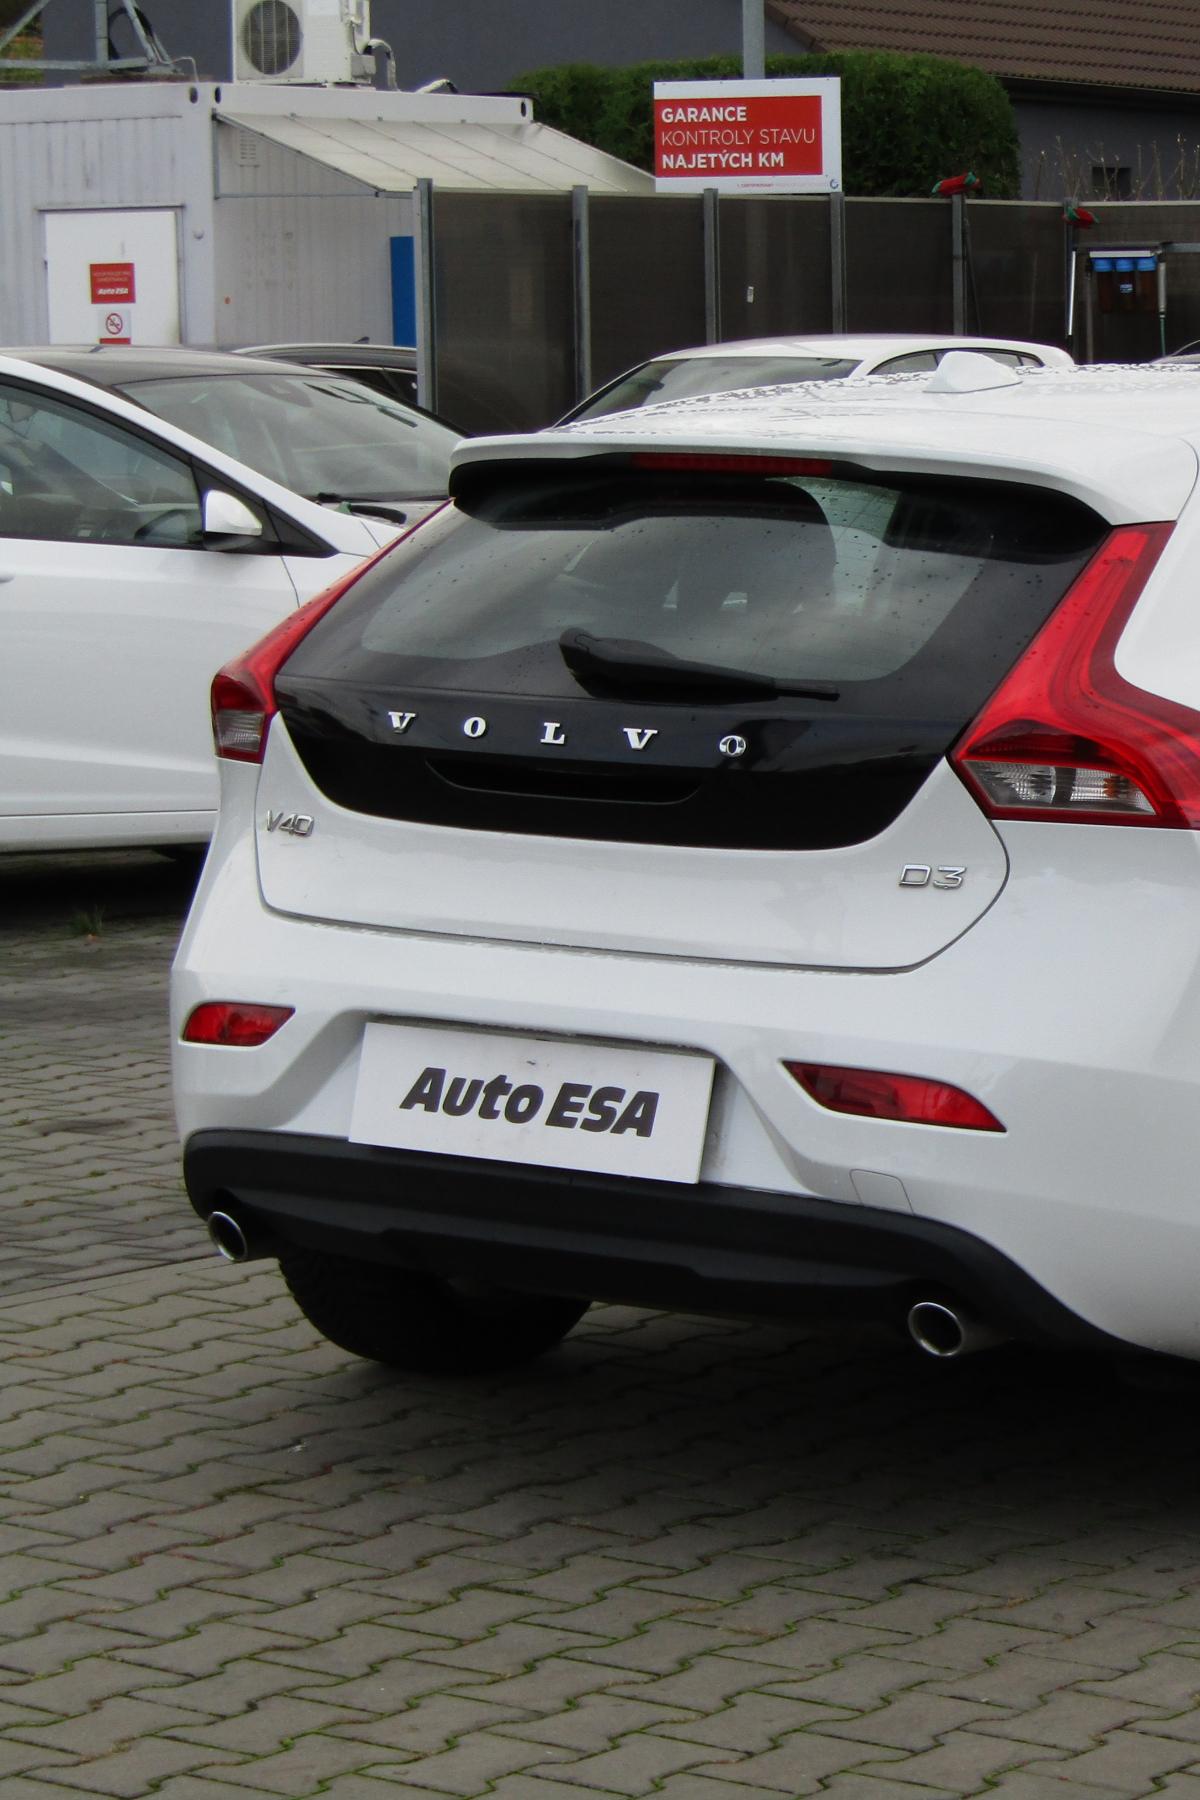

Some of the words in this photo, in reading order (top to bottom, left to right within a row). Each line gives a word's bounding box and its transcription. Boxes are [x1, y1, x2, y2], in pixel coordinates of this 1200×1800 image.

[661, 106, 747, 122] GARANCE
[661, 129, 754, 146] KONTROLY
[759, 128, 815, 144] STAVU
[662, 149, 753, 168] NAJETÝCH
[758, 152, 784, 167] KM
[388, 711, 748, 757] VOLVO
[266, 809, 315, 837] V40
[899, 864, 967, 889] D3
[399, 1067, 545, 1124] Auto
[545, 1082, 660, 1138] ESA
